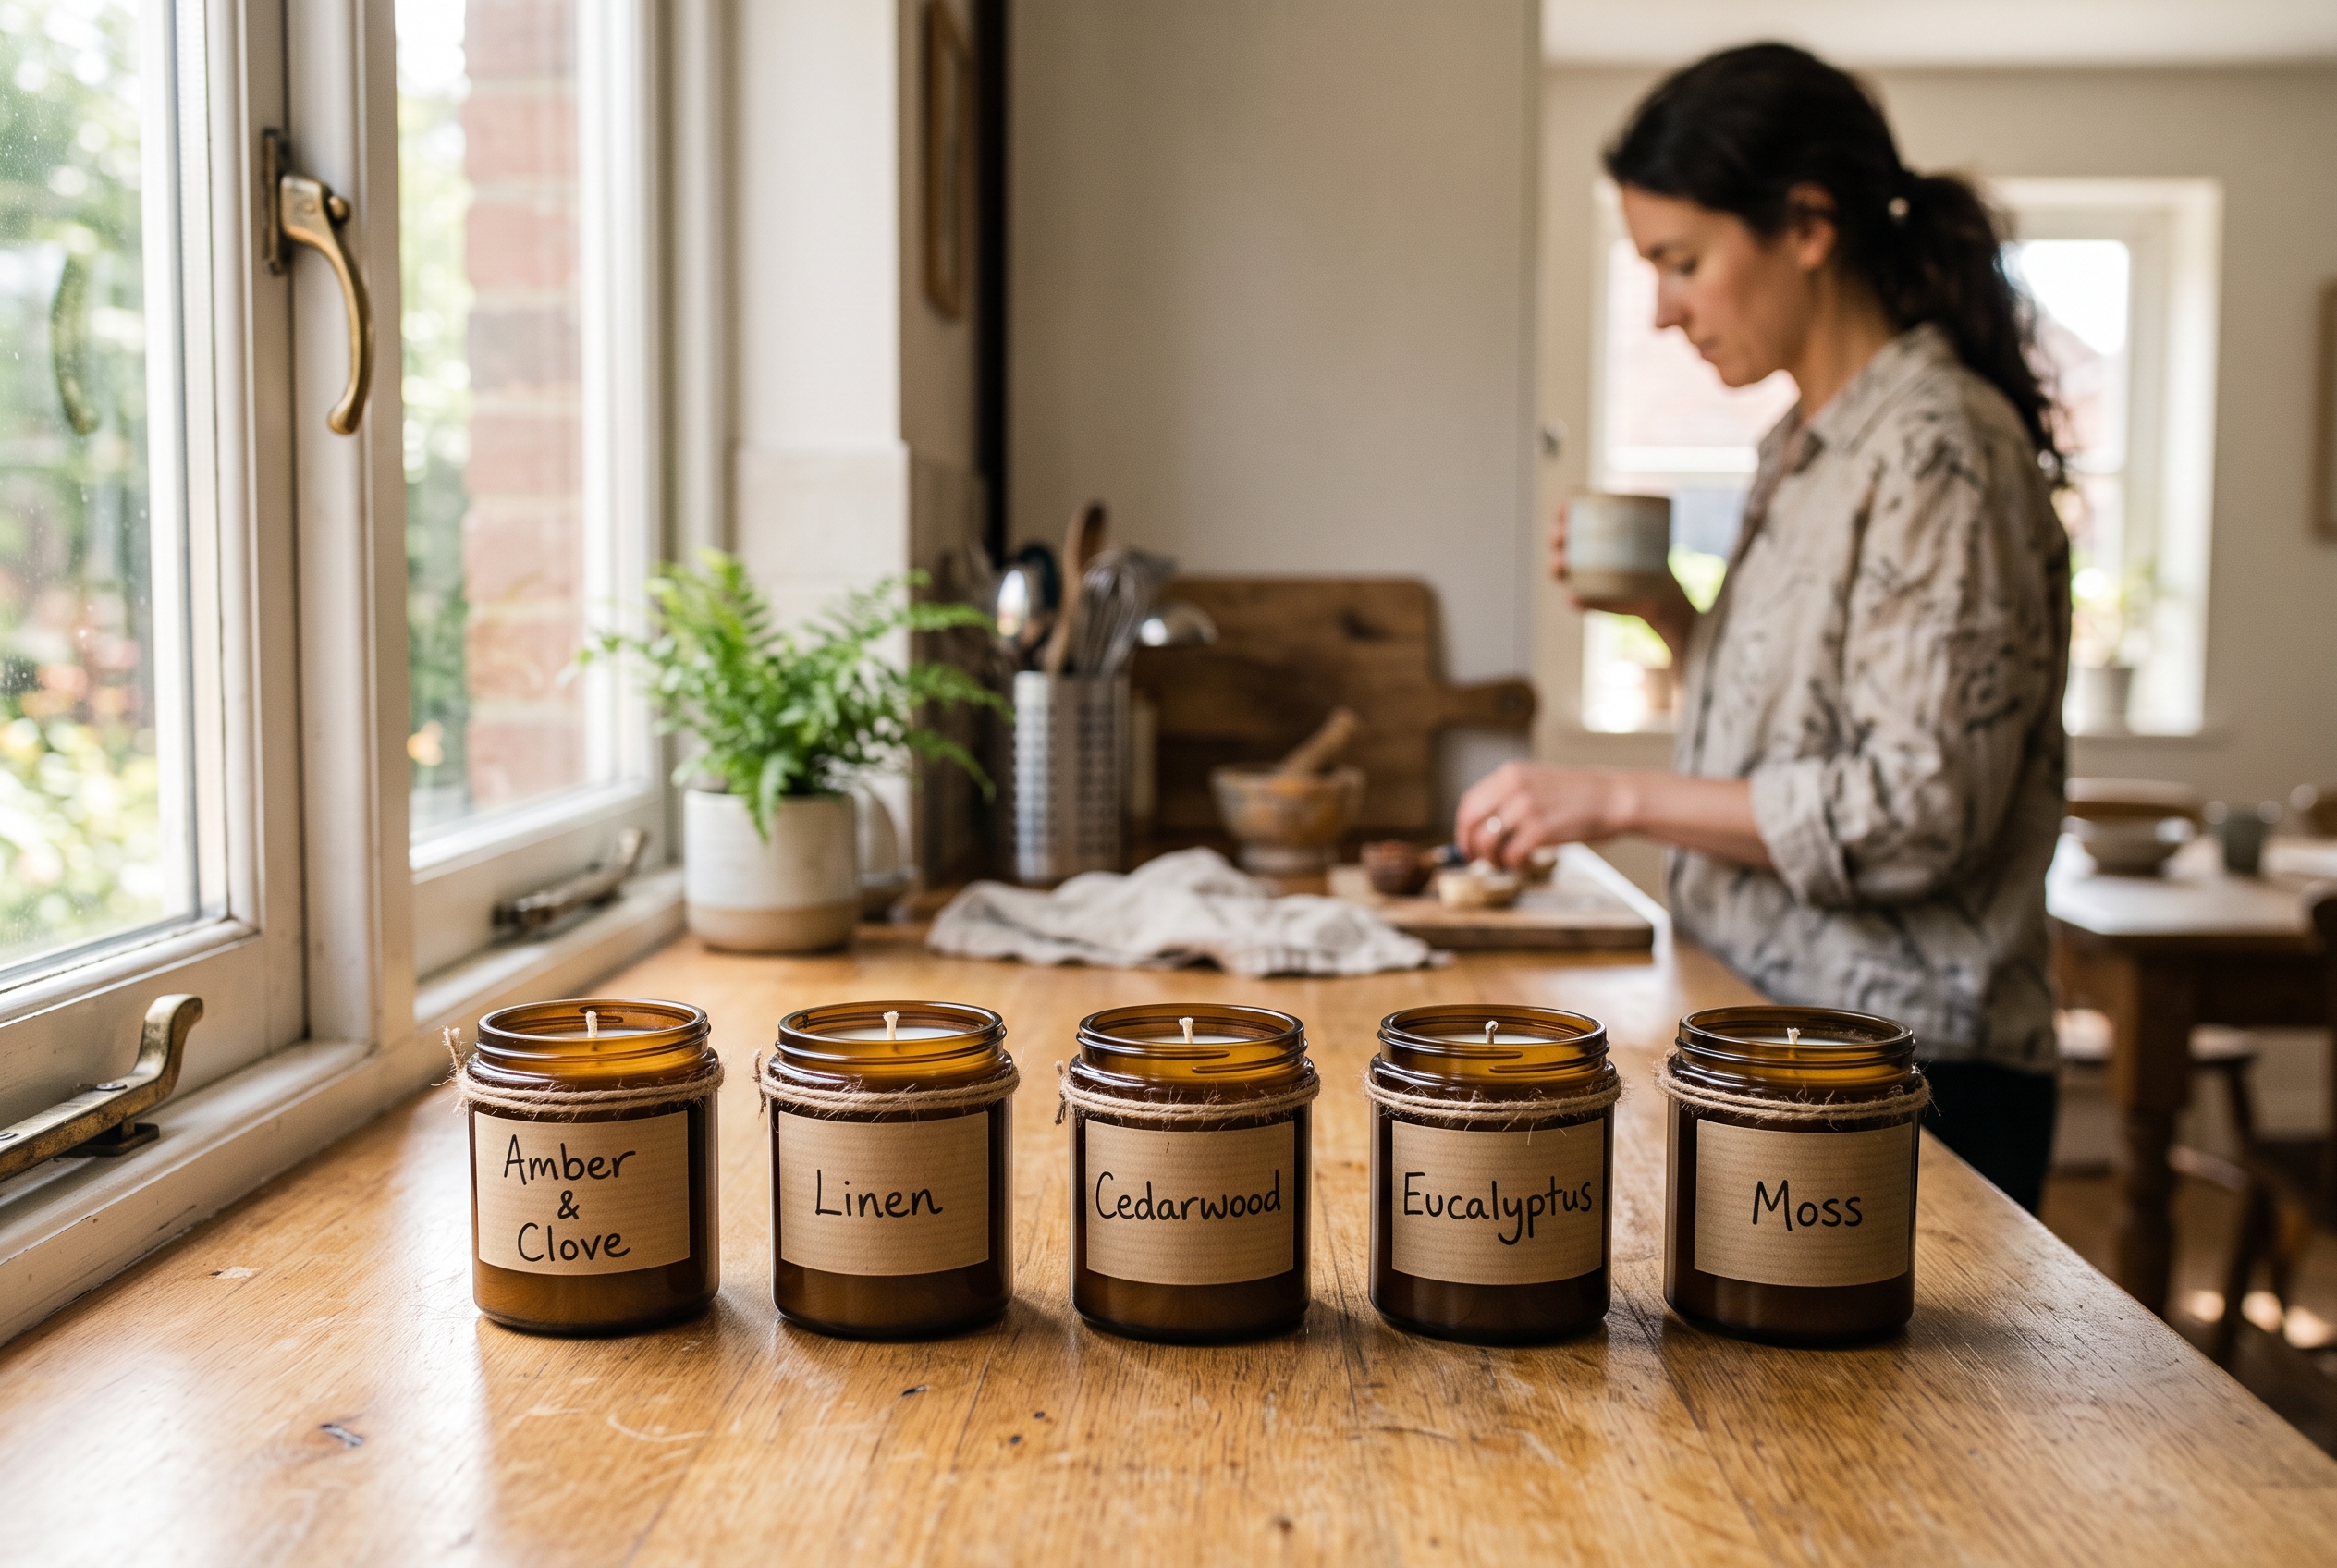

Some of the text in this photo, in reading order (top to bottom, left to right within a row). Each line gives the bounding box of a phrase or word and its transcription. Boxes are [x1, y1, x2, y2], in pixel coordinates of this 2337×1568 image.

[504, 1133, 637, 1186] Amber
[557, 1189, 580, 1220] &
[814, 1169, 945, 1219] Linen
[1095, 1170, 1281, 1221] Cedarwood
[1403, 1171, 1593, 1246] Eucalyptus
[1752, 1179, 1863, 1232] Moss
[518, 1222, 631, 1262] Clove
